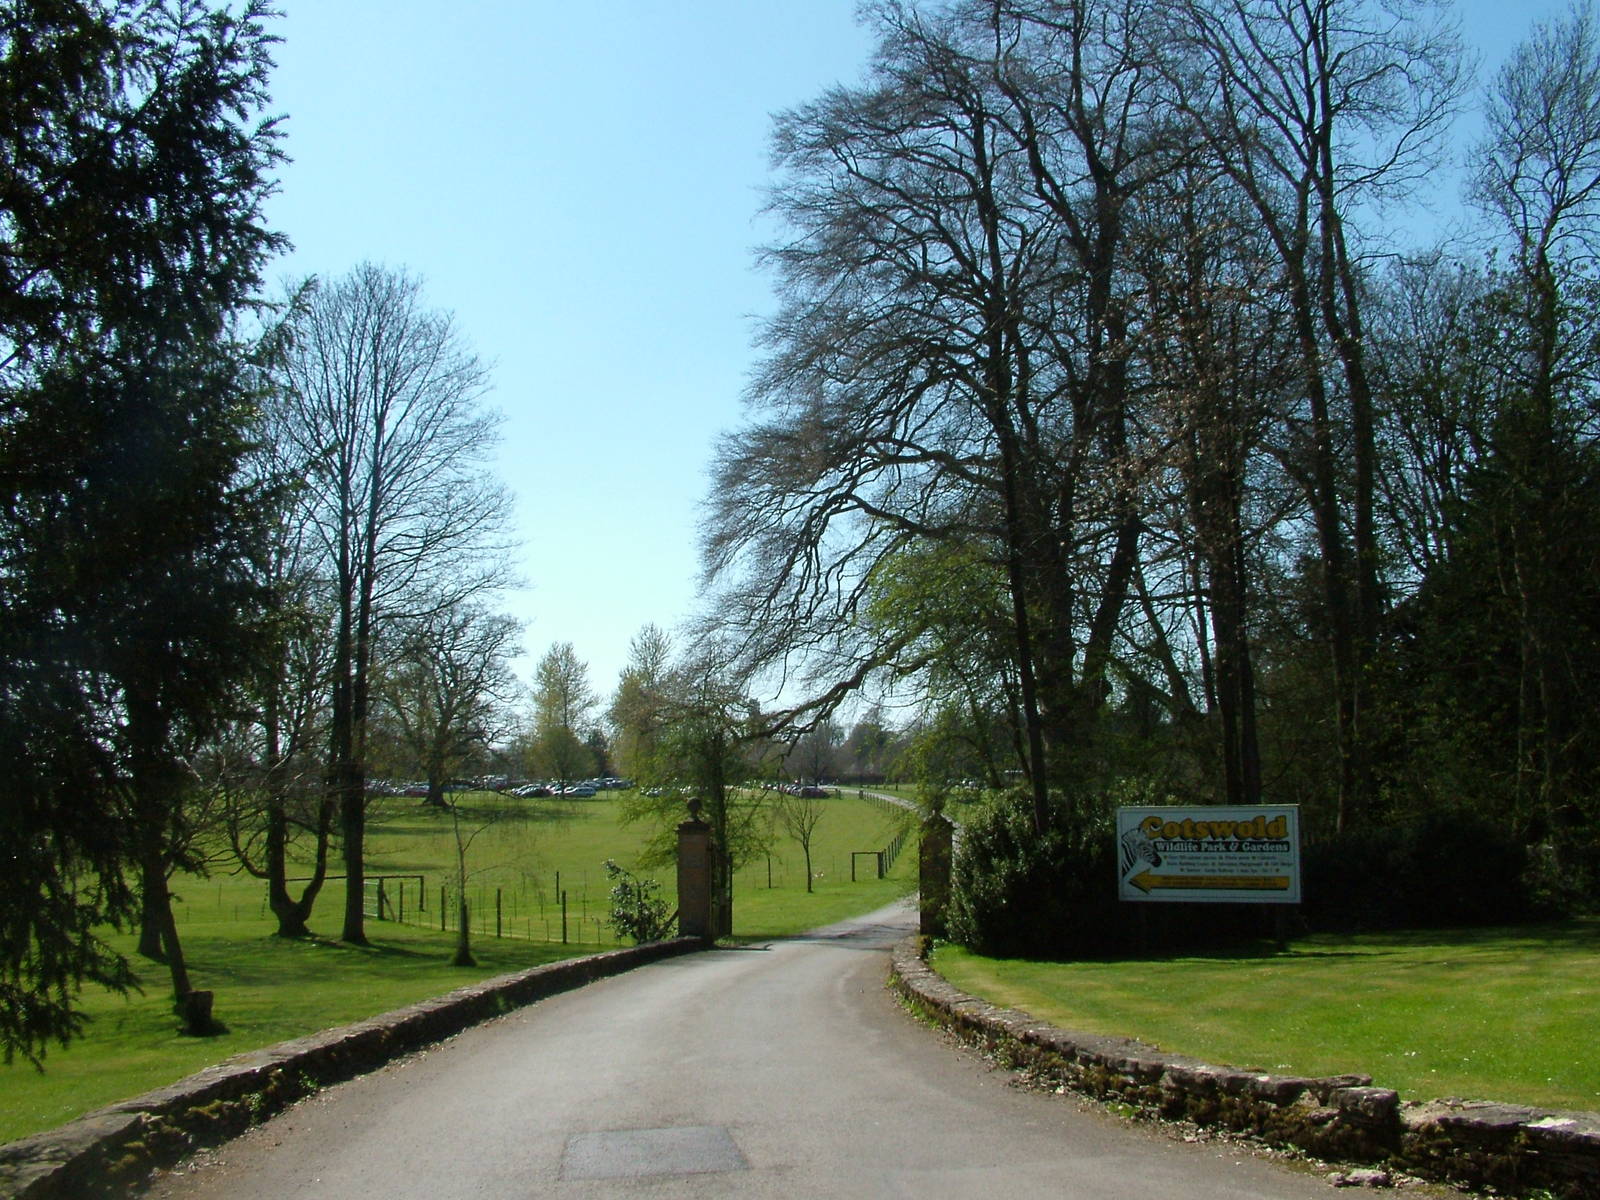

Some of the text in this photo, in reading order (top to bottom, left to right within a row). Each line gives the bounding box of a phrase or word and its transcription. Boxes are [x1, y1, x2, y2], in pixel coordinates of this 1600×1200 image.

[1142, 815, 1289, 840] Cotswold
[1157, 841, 1288, 851] Wildlife Park & Gardens
